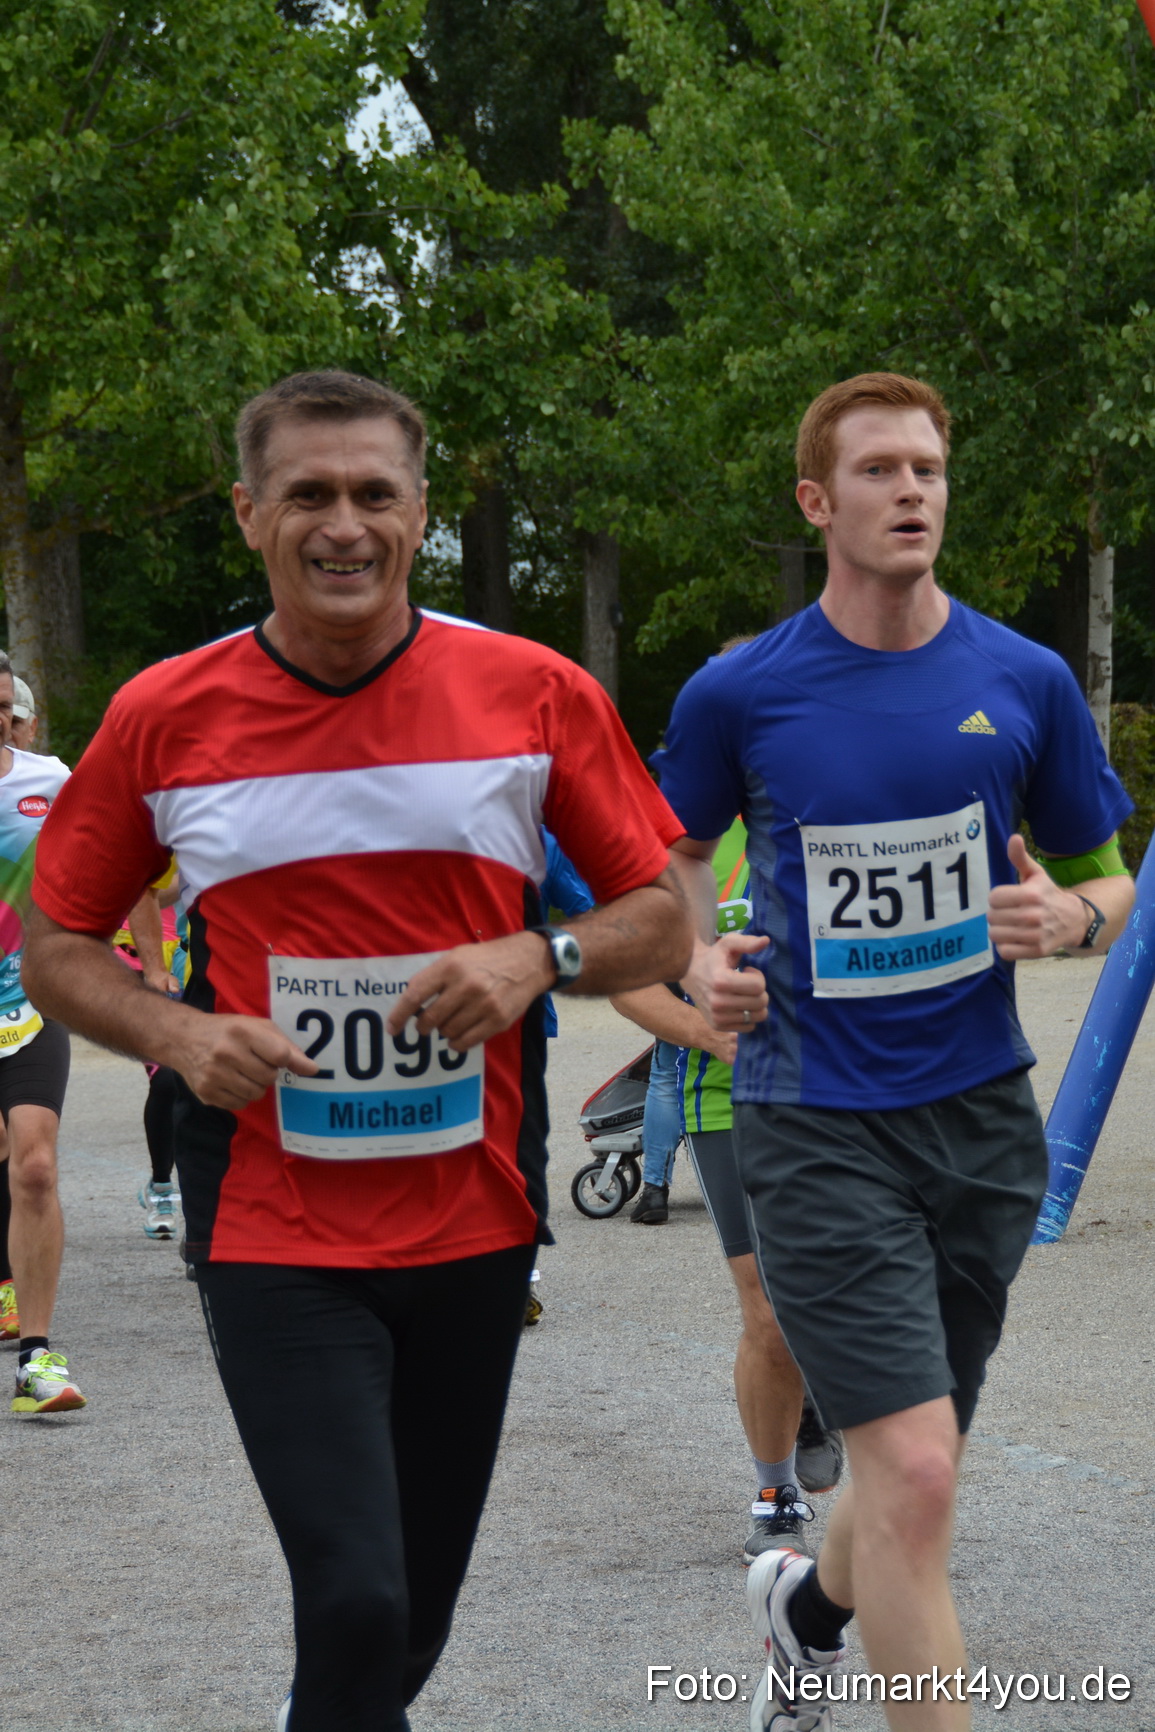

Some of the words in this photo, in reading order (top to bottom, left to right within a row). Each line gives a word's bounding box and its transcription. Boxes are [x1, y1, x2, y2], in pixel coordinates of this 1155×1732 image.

[958, 725, 996, 735] adidas
[808, 842, 868, 857] PARTL
[873, 831, 961, 857] Neumarkt
[828, 851, 970, 929] 2511
[847, 935, 965, 972] Alexander
[276, 976, 348, 997] PARTL
[329, 1095, 442, 1130] Michael
